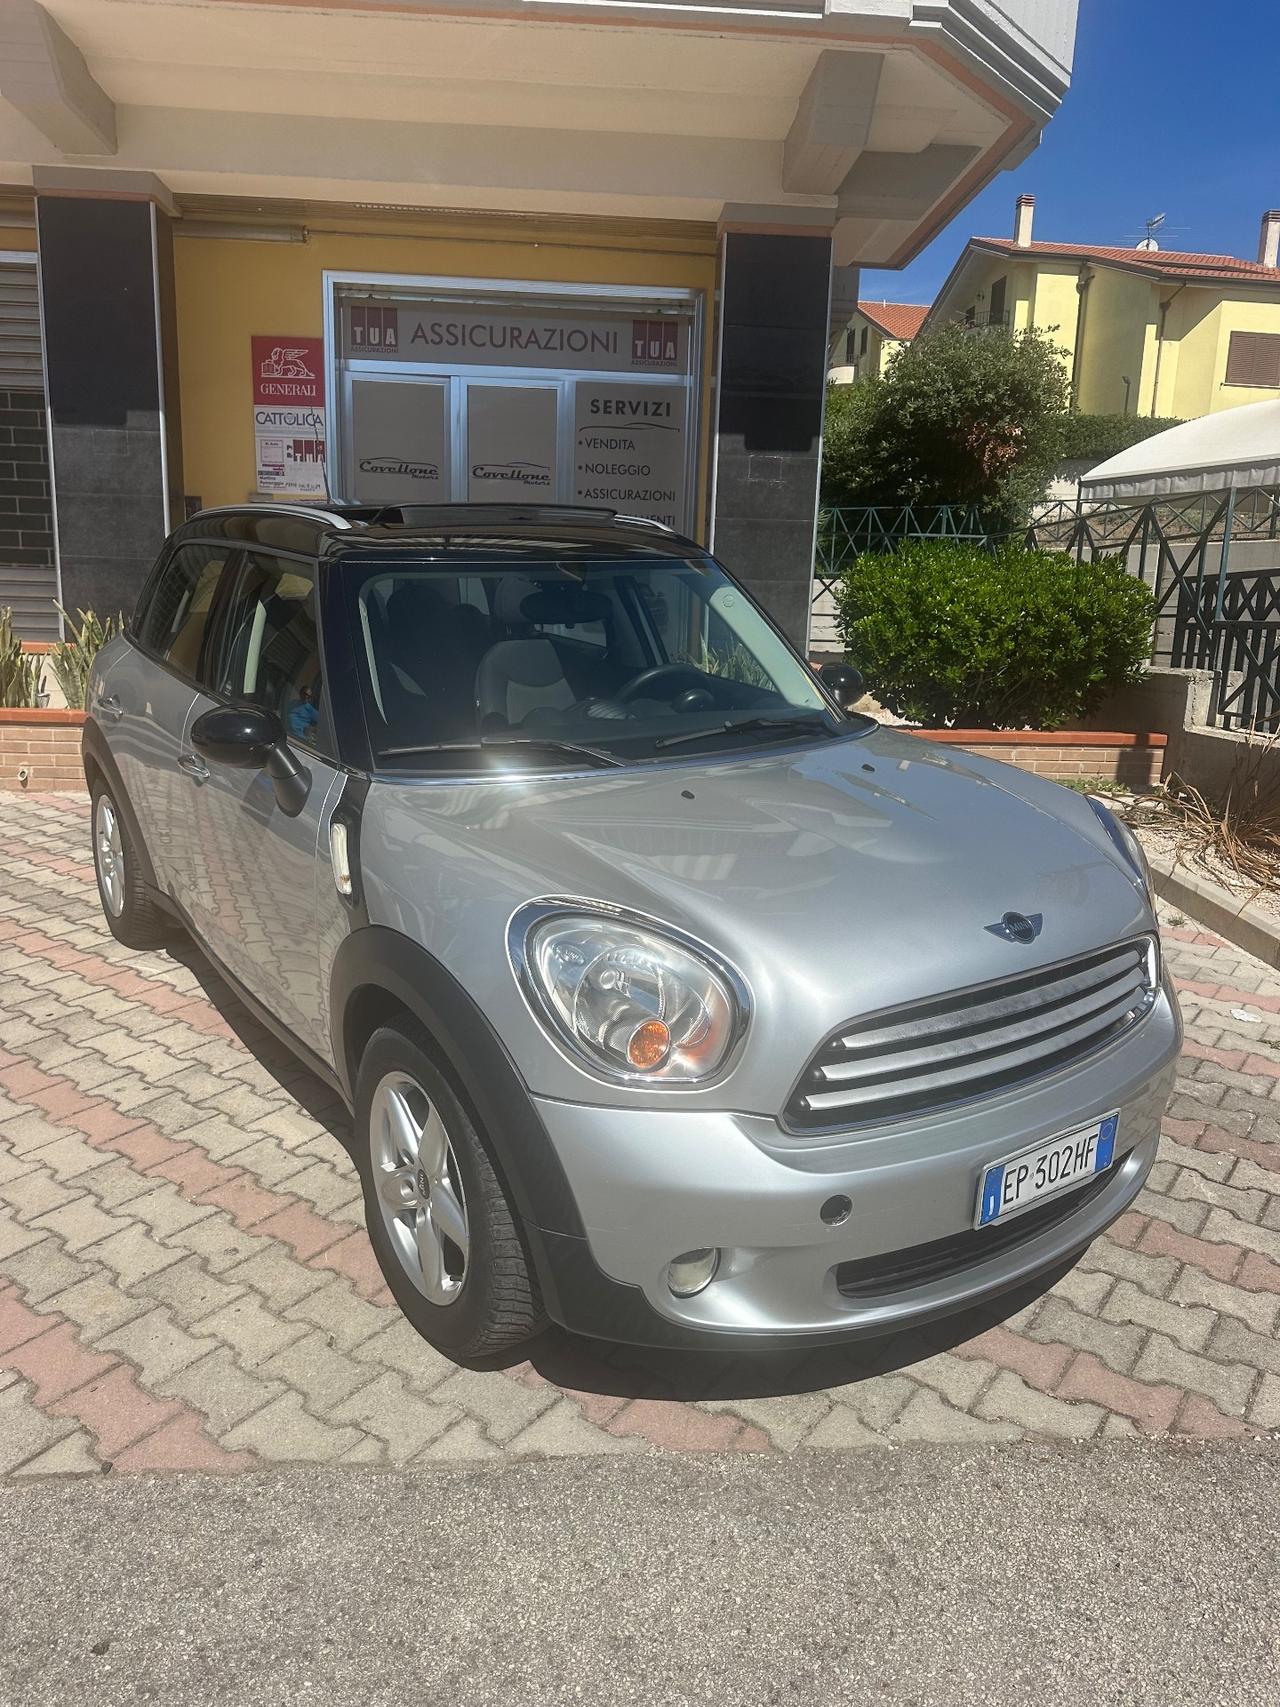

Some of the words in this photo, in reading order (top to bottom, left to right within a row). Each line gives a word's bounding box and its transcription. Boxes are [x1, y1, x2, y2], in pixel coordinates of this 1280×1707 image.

[353, 326, 396, 345] TUA
[410, 321, 618, 354] ASSICURAZIONI
[634, 340, 676, 359] TUA
[260, 383, 316, 396] GENERALI
[590, 398, 671, 417] SERVIZI
[255, 411, 324, 427] CATTOLICA
[585, 438, 636, 451] VENDITA
[359, 460, 439, 476] Covellone
[472, 466, 551, 481] Covellone
[585, 463, 651, 476] NOLEGGIO
[584, 488, 676, 502] ASSICURAZIONI
[1003, 1164, 1029, 1205] EP
[1034, 1133, 1099, 1190] 302HF
